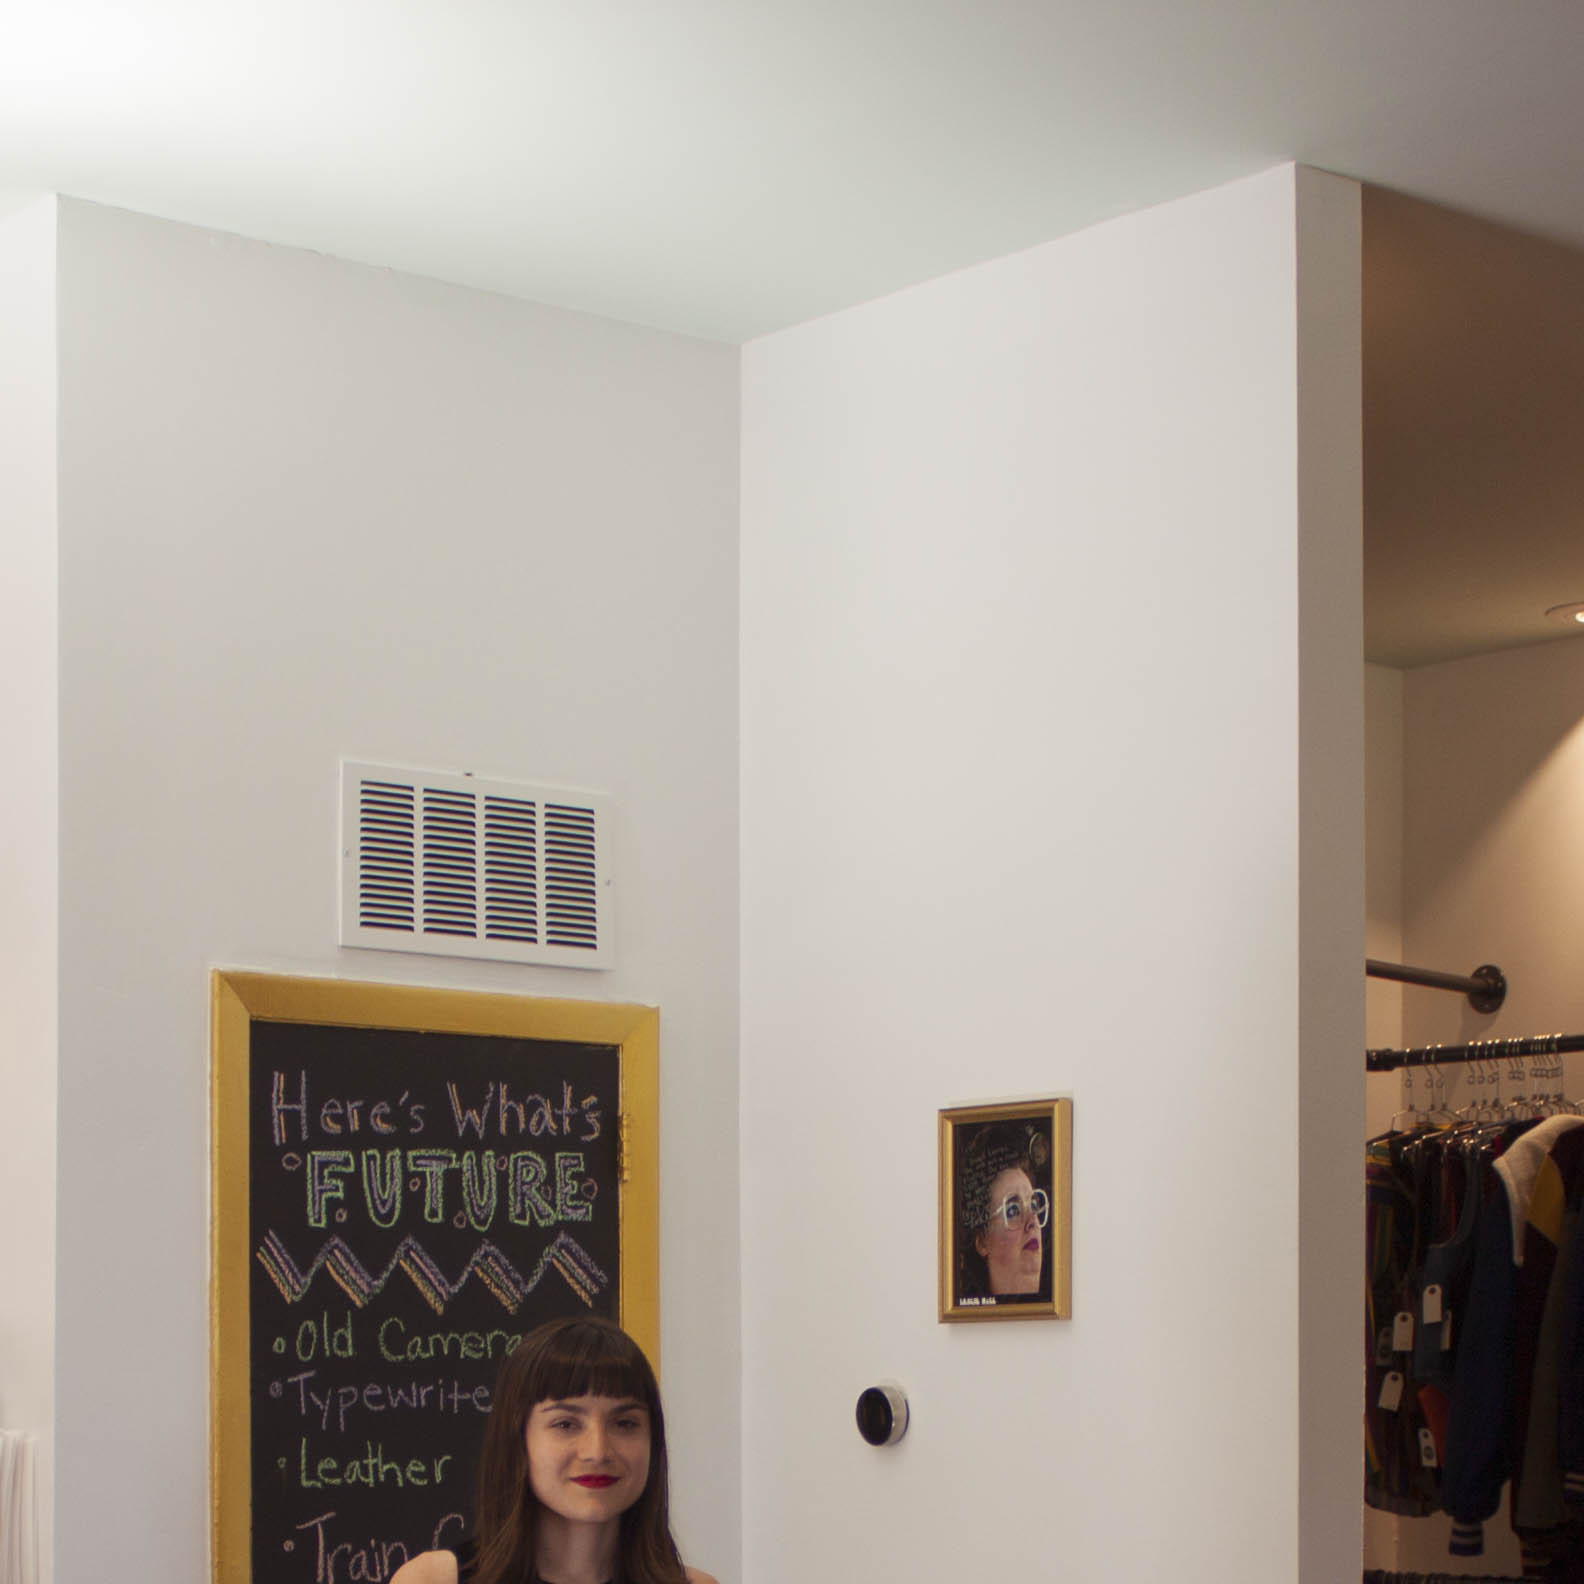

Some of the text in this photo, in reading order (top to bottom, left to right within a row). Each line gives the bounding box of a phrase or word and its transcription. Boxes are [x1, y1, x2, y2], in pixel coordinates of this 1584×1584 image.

[271, 1068, 426, 1147] Here's
[306, 1149, 593, 1231] FUTURE
[295, 1310, 355, 1362] Old
[300, 1436, 454, 1489] Leather
